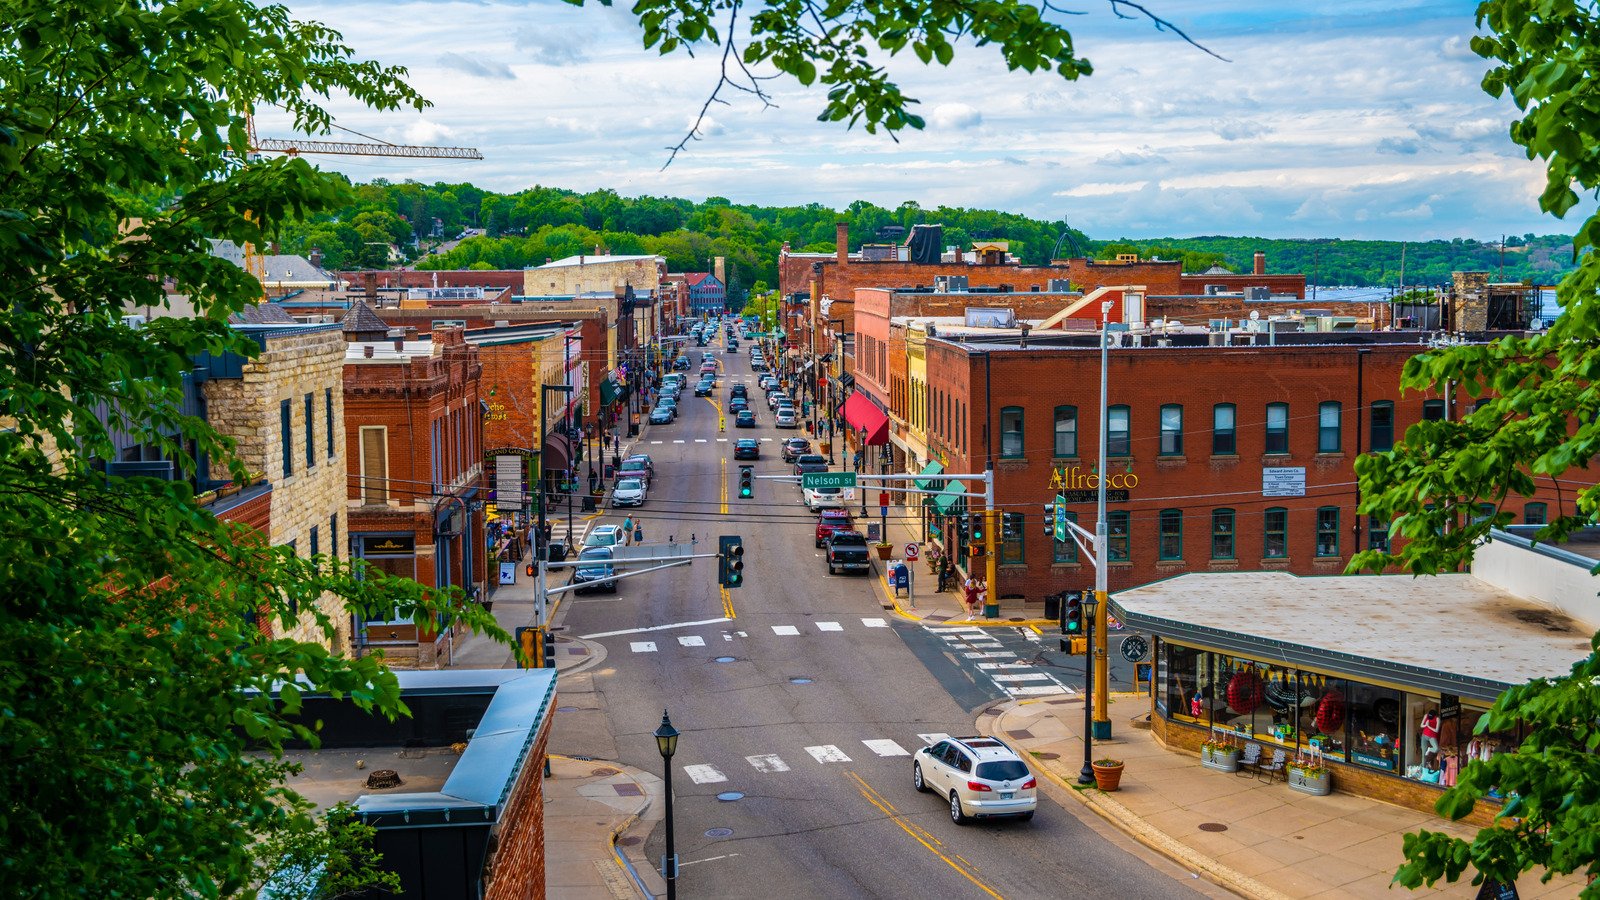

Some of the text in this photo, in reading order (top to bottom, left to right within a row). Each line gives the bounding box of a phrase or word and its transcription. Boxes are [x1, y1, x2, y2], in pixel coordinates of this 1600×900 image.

[485, 449, 508, 457] GRAND
[807, 476, 852, 485] Nelson St
[1047, 466, 1138, 489] Alfresco
